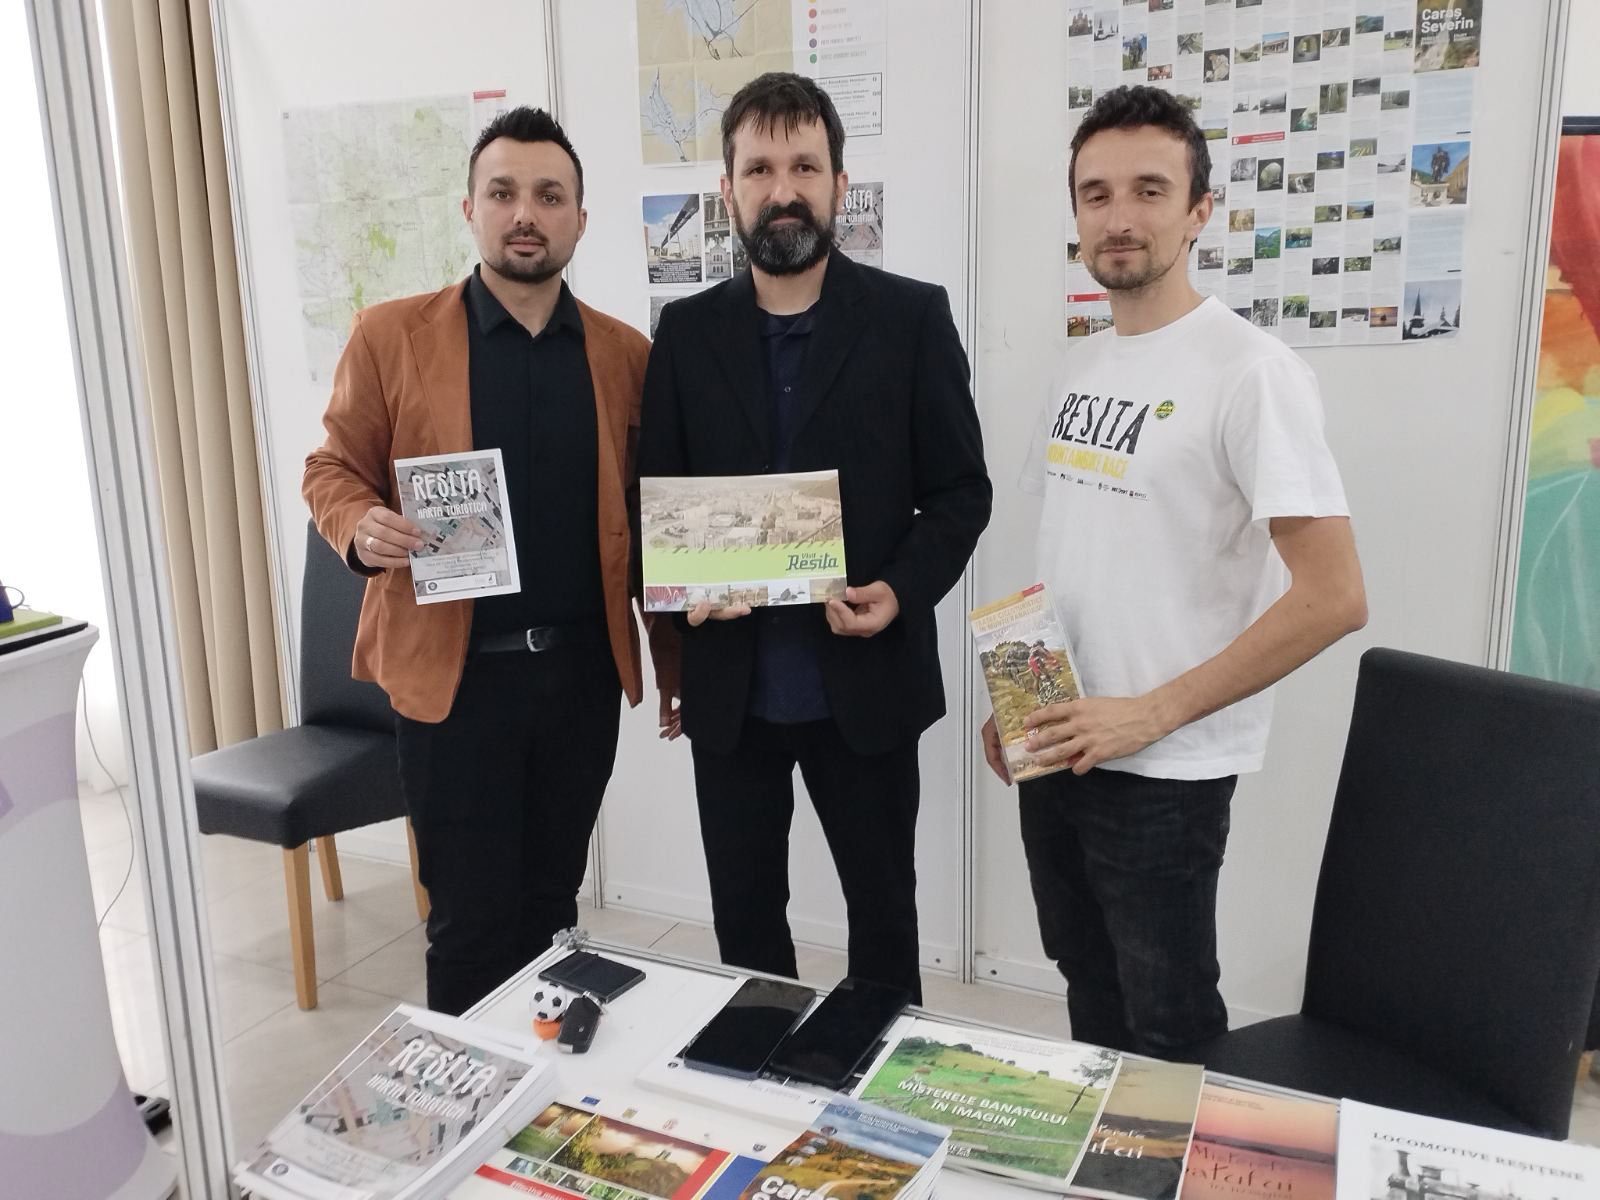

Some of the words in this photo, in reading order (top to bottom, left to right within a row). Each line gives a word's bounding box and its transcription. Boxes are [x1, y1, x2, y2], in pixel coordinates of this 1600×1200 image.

[1421, 16, 1474, 33] Severin
[842, 189, 873, 212] ȘIȚA
[897, 1080, 980, 1105] MISTERELE
[979, 1099, 1069, 1126] BANATULUI
[951, 1106, 1018, 1128] IMAGINI
[1373, 1131, 1490, 1162] LOCOMOTIVE
